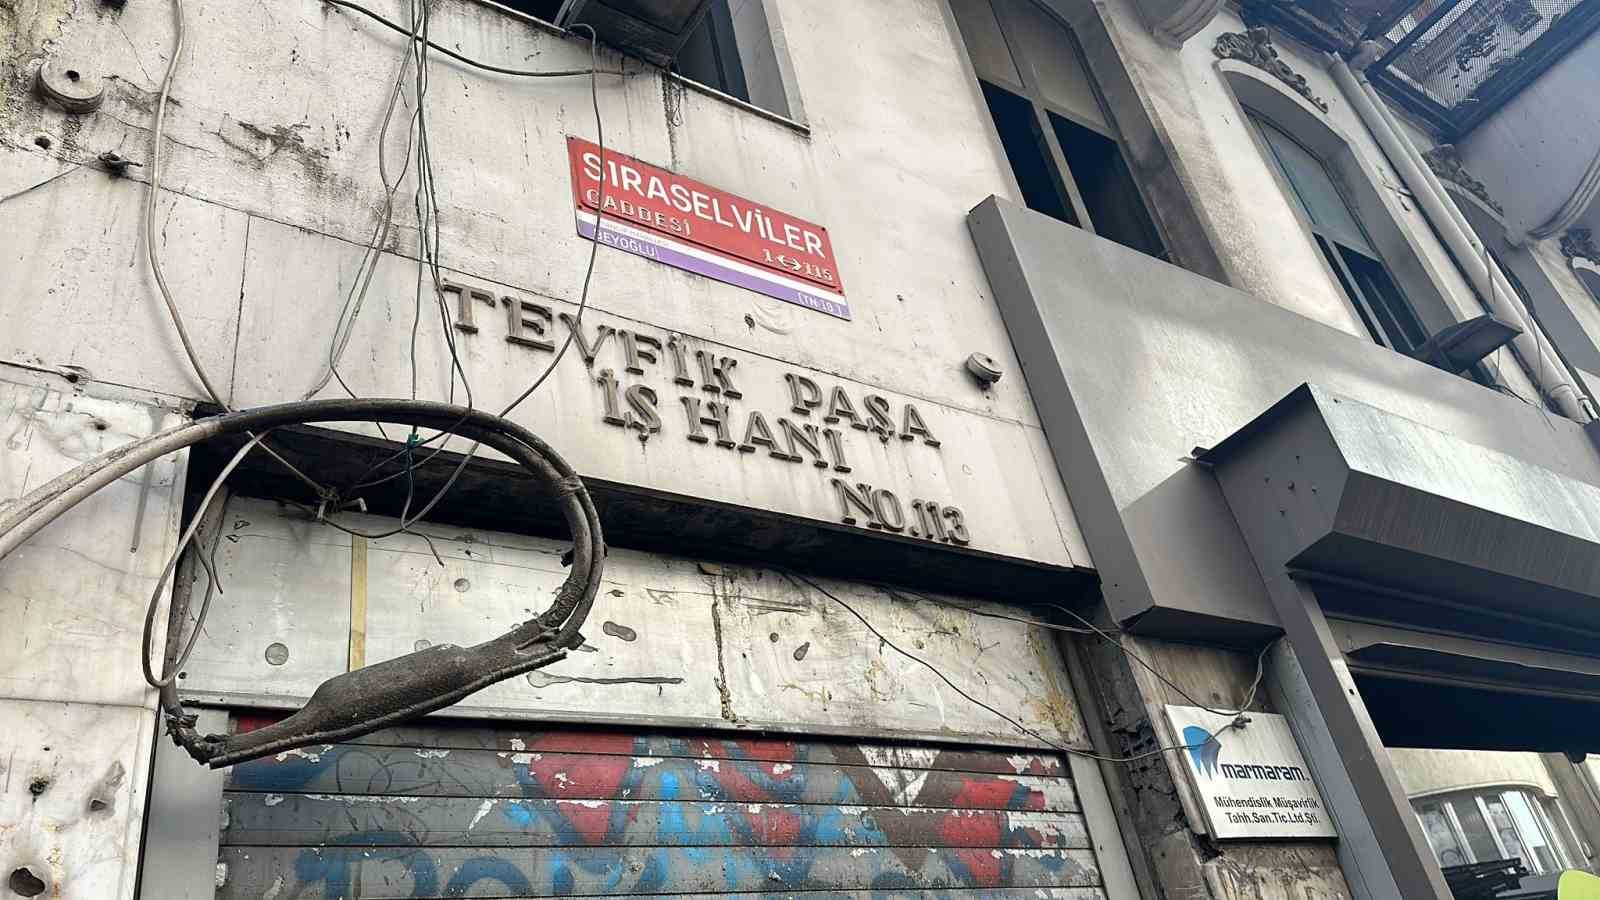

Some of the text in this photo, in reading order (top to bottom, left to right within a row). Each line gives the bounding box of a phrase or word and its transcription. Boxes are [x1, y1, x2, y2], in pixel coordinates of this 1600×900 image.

[582, 152, 826, 258] SIRASELVİLER
[441, 278, 941, 448] TEVFİK PAŞA
[597, 368, 851, 473] İŞ HANI
[831, 478, 969, 546] NO.113
[1213, 796, 1320, 811] Mühendislik Müşavirlik
